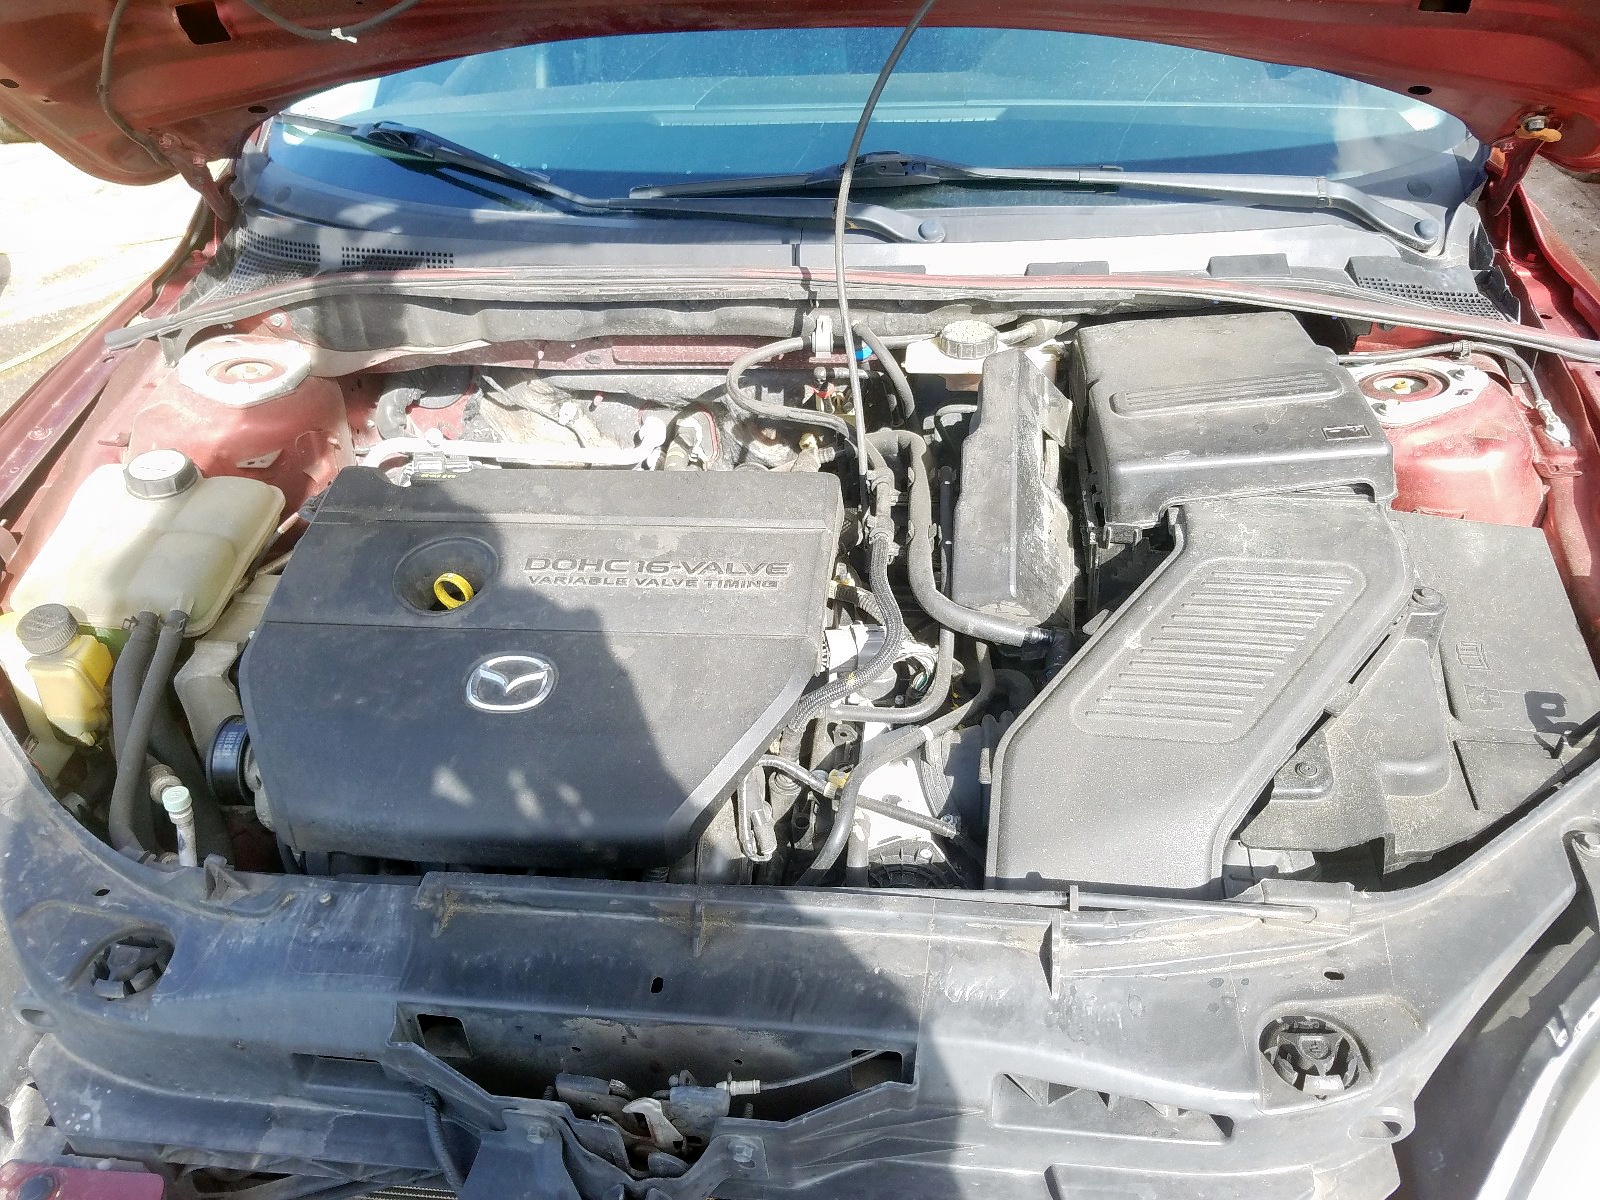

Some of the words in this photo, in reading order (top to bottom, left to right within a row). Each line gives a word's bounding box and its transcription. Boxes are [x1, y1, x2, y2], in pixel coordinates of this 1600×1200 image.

[524, 558, 629, 573] DOHC
[636, 560, 789, 575] 16-VALVE
[528, 576, 628, 586] VARIABLE
[635, 578, 698, 588] VALVE
[704, 579, 779, 589] TIMING
